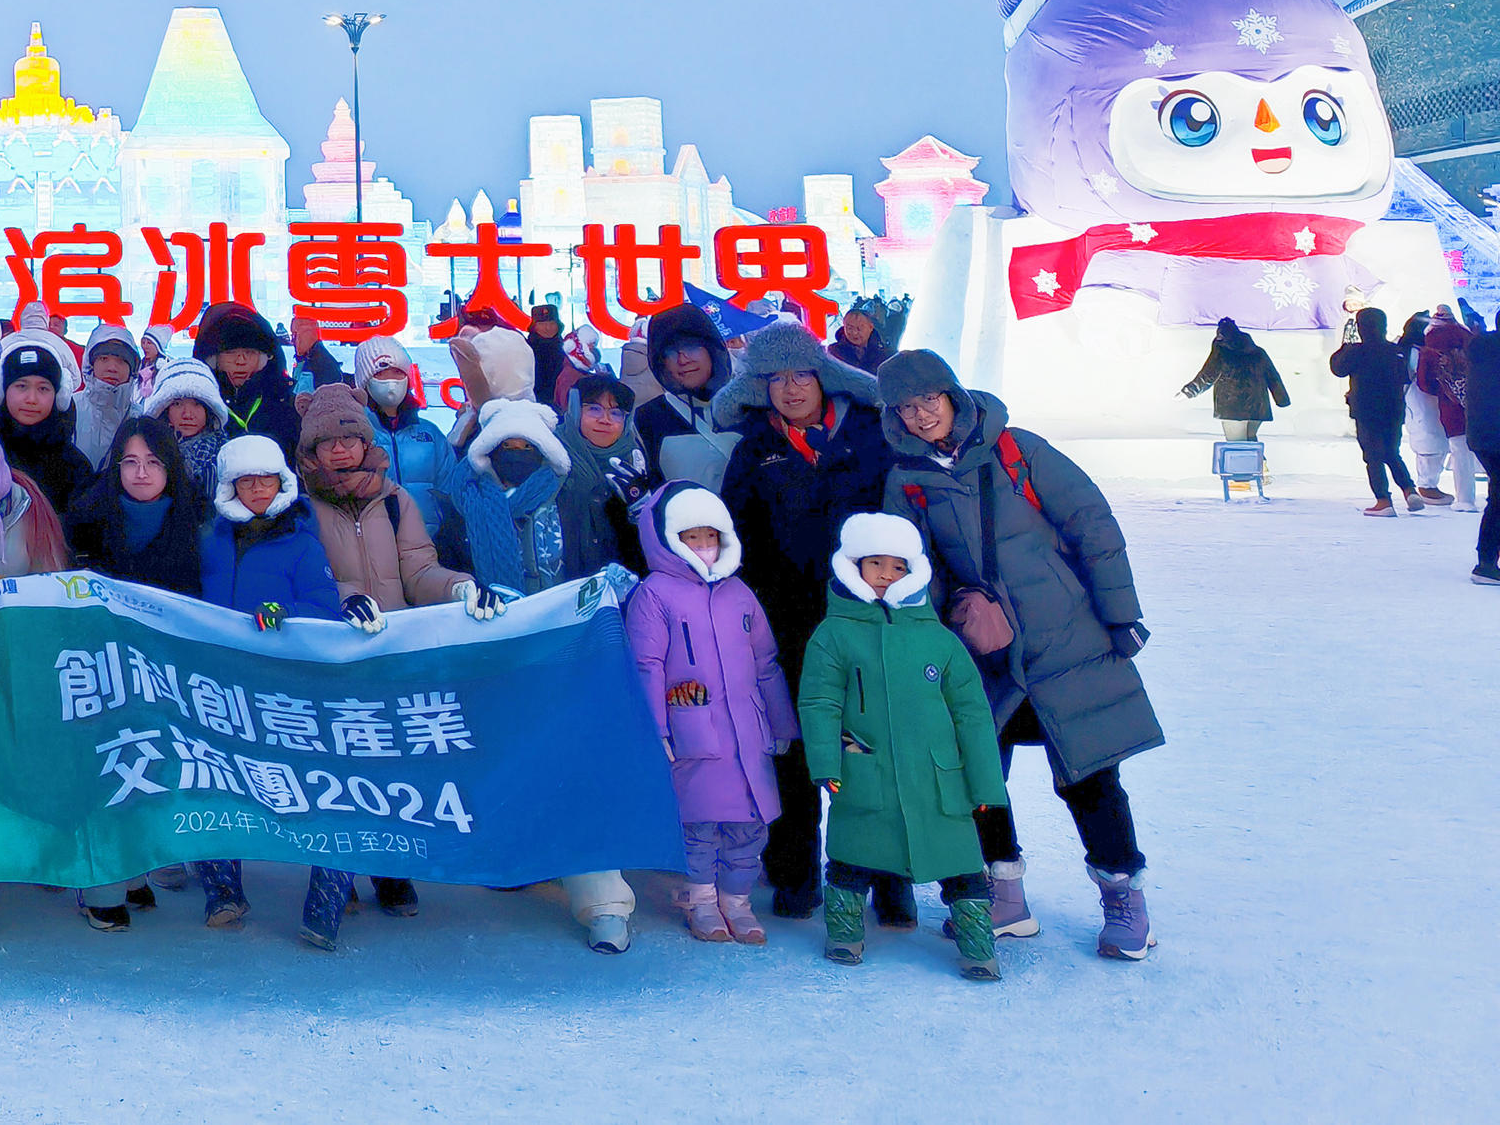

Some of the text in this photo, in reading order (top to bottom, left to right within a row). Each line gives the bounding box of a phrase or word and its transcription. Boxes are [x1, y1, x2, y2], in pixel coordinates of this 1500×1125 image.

[54, 641, 477, 757] 創科創意產業
[95, 724, 473, 834] 交流團2024
